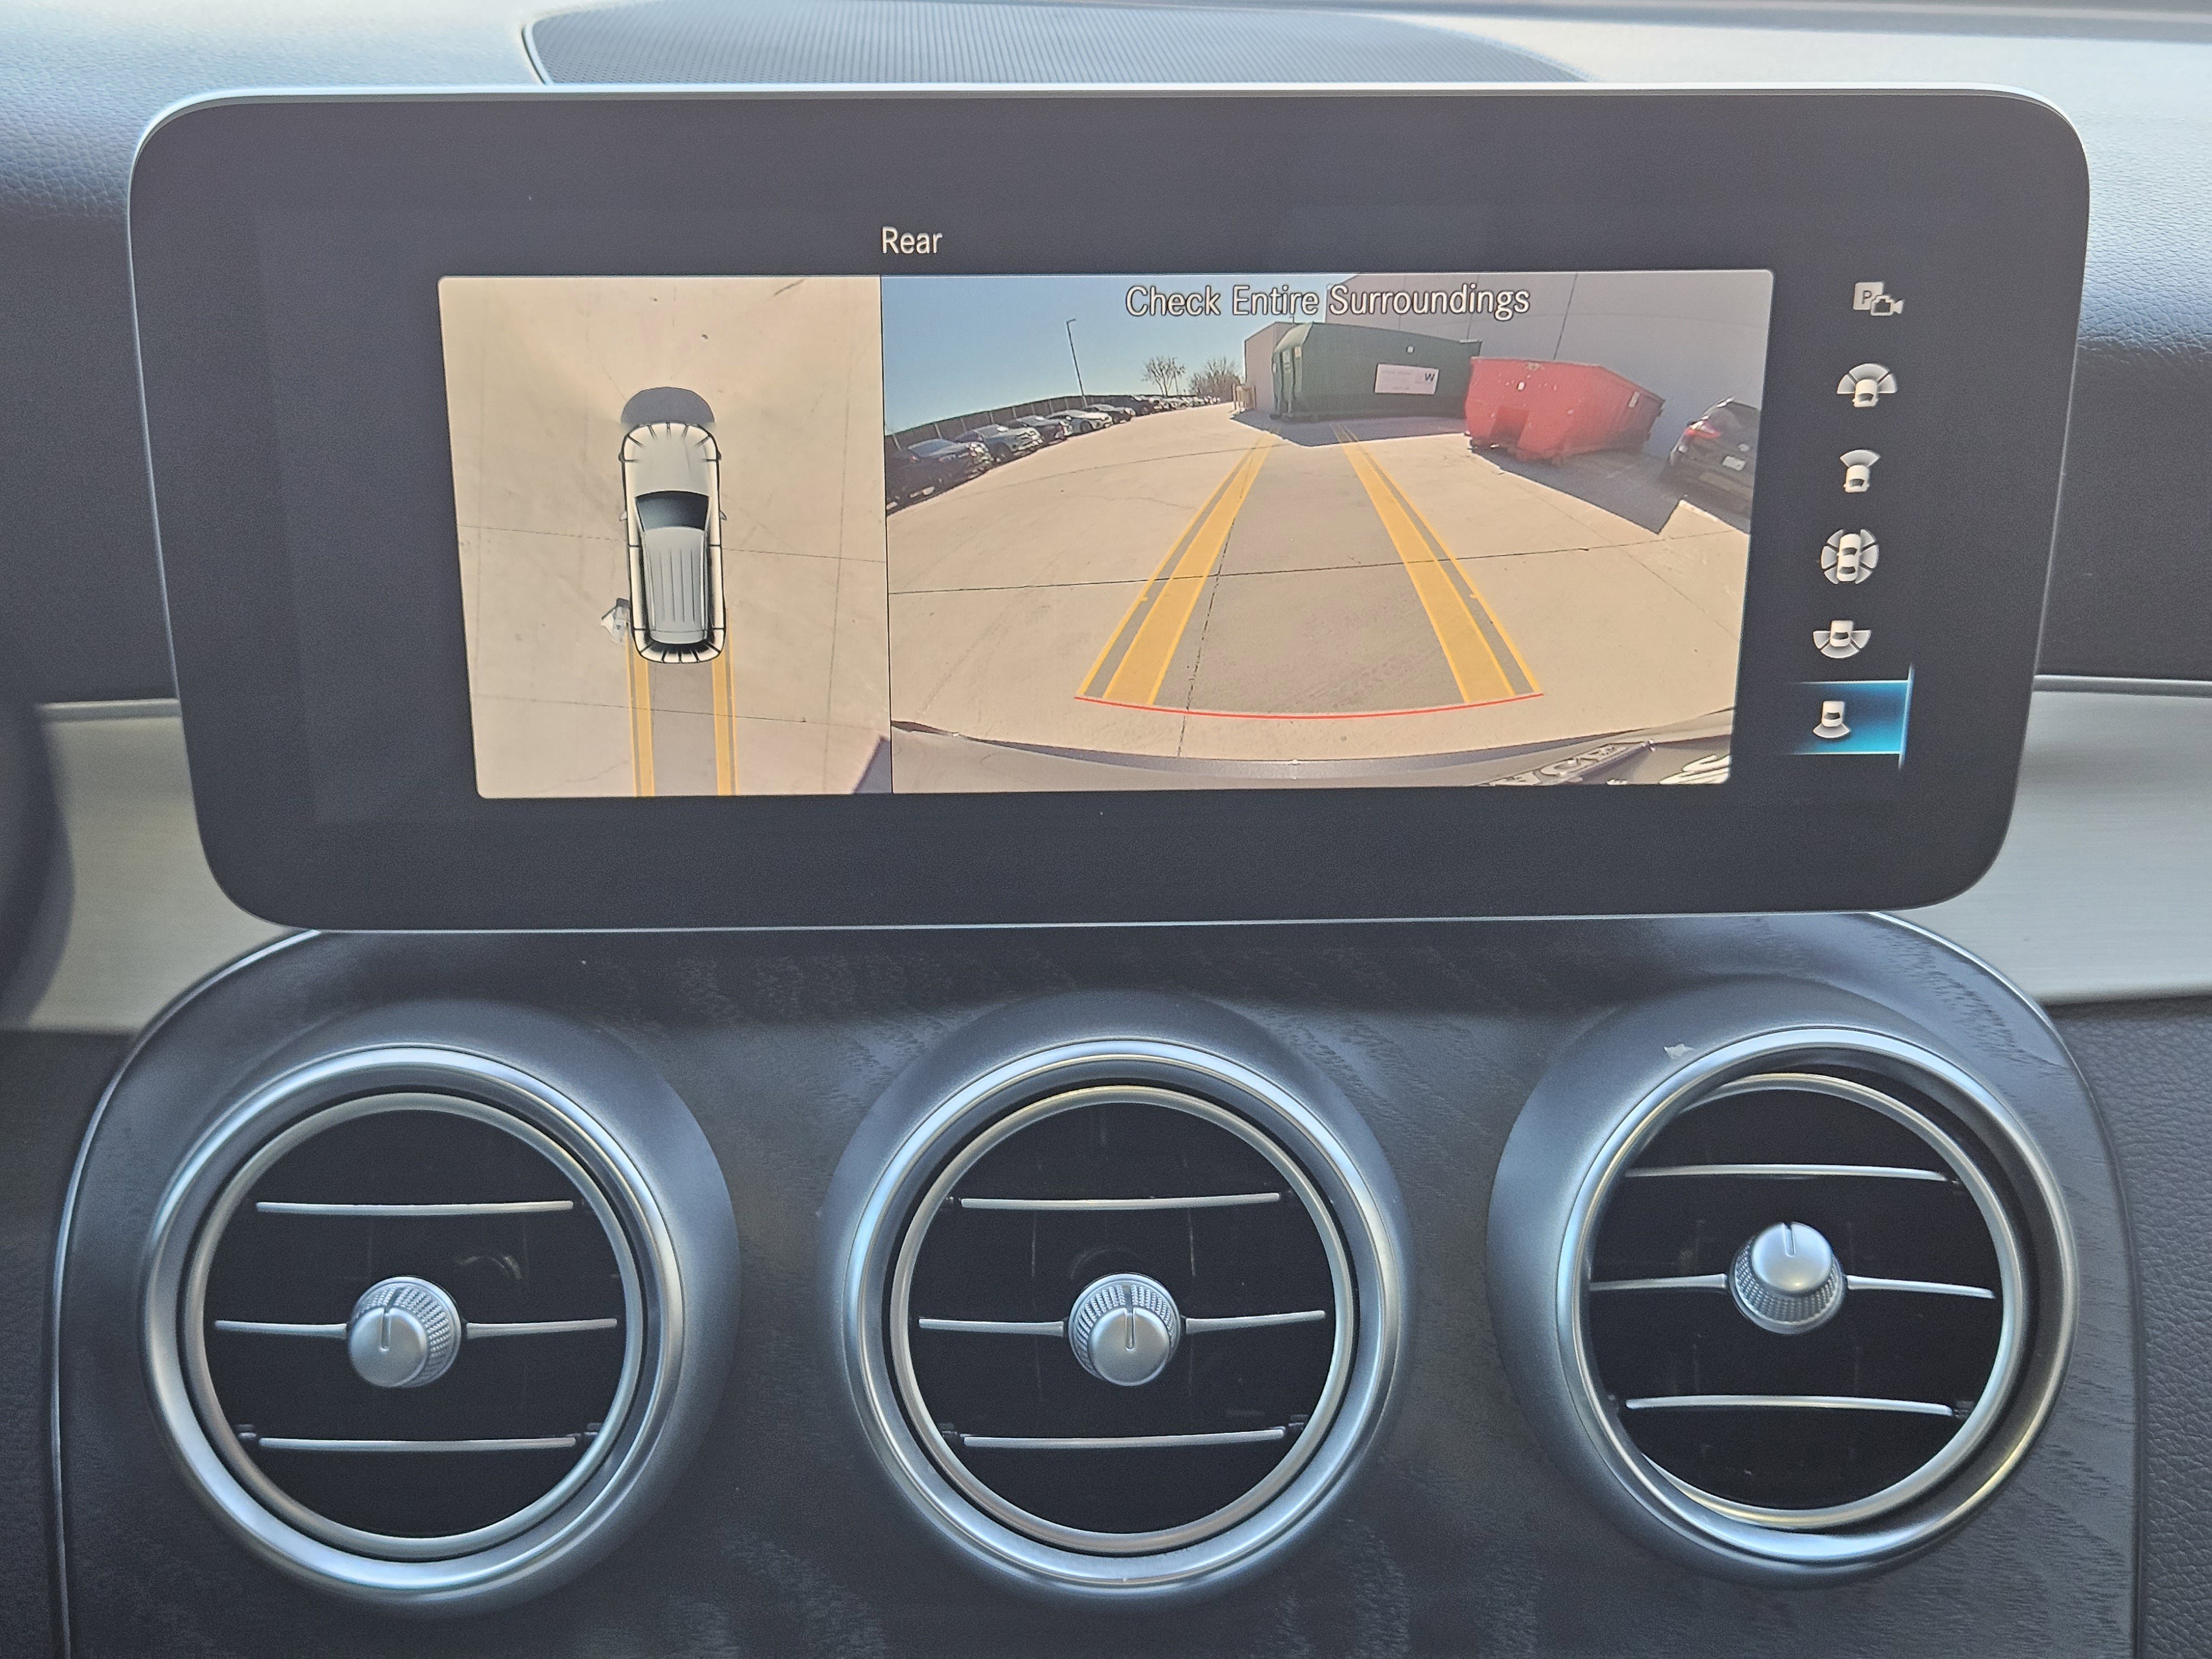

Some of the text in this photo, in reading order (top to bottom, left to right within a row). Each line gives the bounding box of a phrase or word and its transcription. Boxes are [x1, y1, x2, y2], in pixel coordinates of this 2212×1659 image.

[881, 226, 943, 254] Rear
[1125, 283, 1530, 321] Check Entire Surroundings
